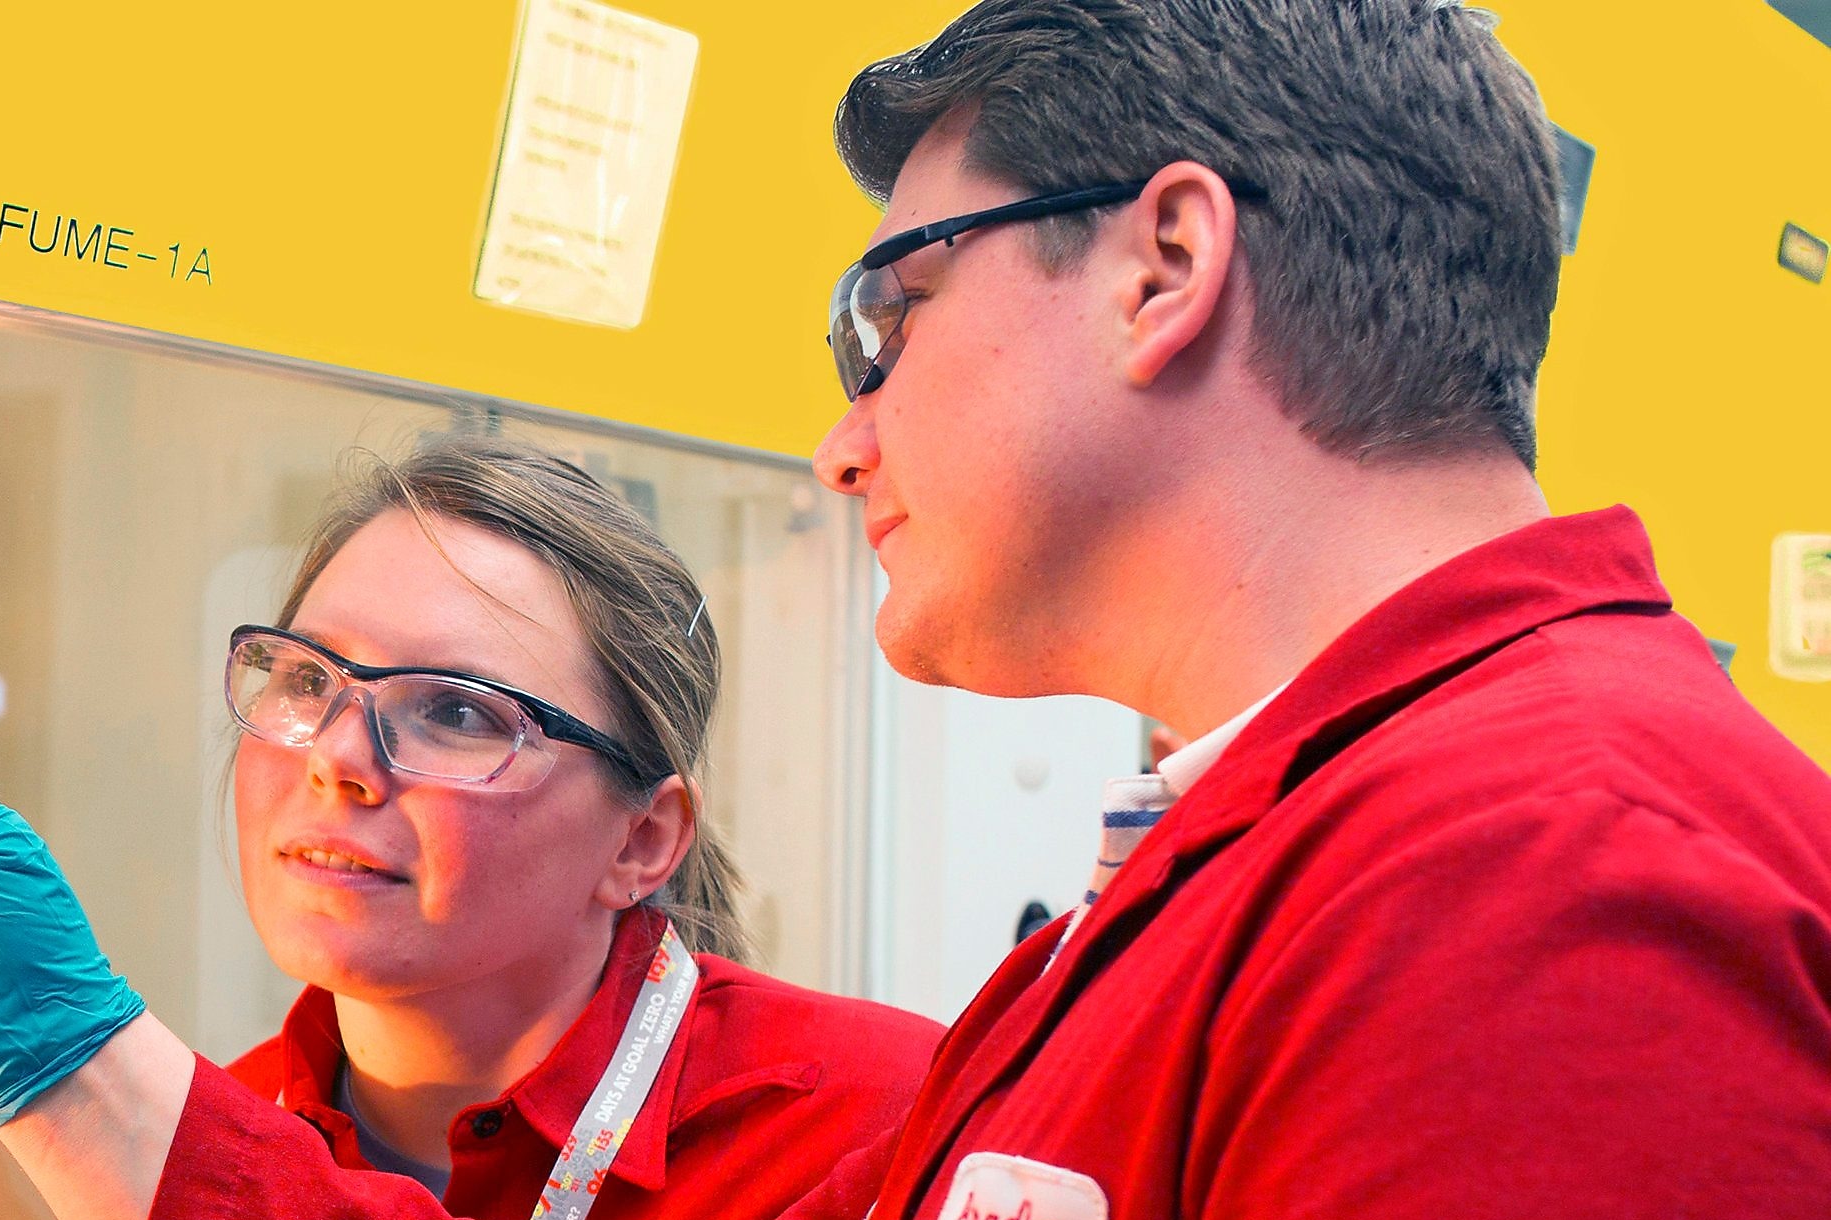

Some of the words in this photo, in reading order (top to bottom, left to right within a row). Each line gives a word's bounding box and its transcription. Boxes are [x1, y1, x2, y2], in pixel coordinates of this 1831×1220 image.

[639, 992, 666, 1034] ZERO
[653, 1005, 677, 1044] WHAT'S
[622, 1036, 650, 1074] GOAL
[613, 1073, 632, 1092] AT
[594, 1090, 623, 1124] DAYS
